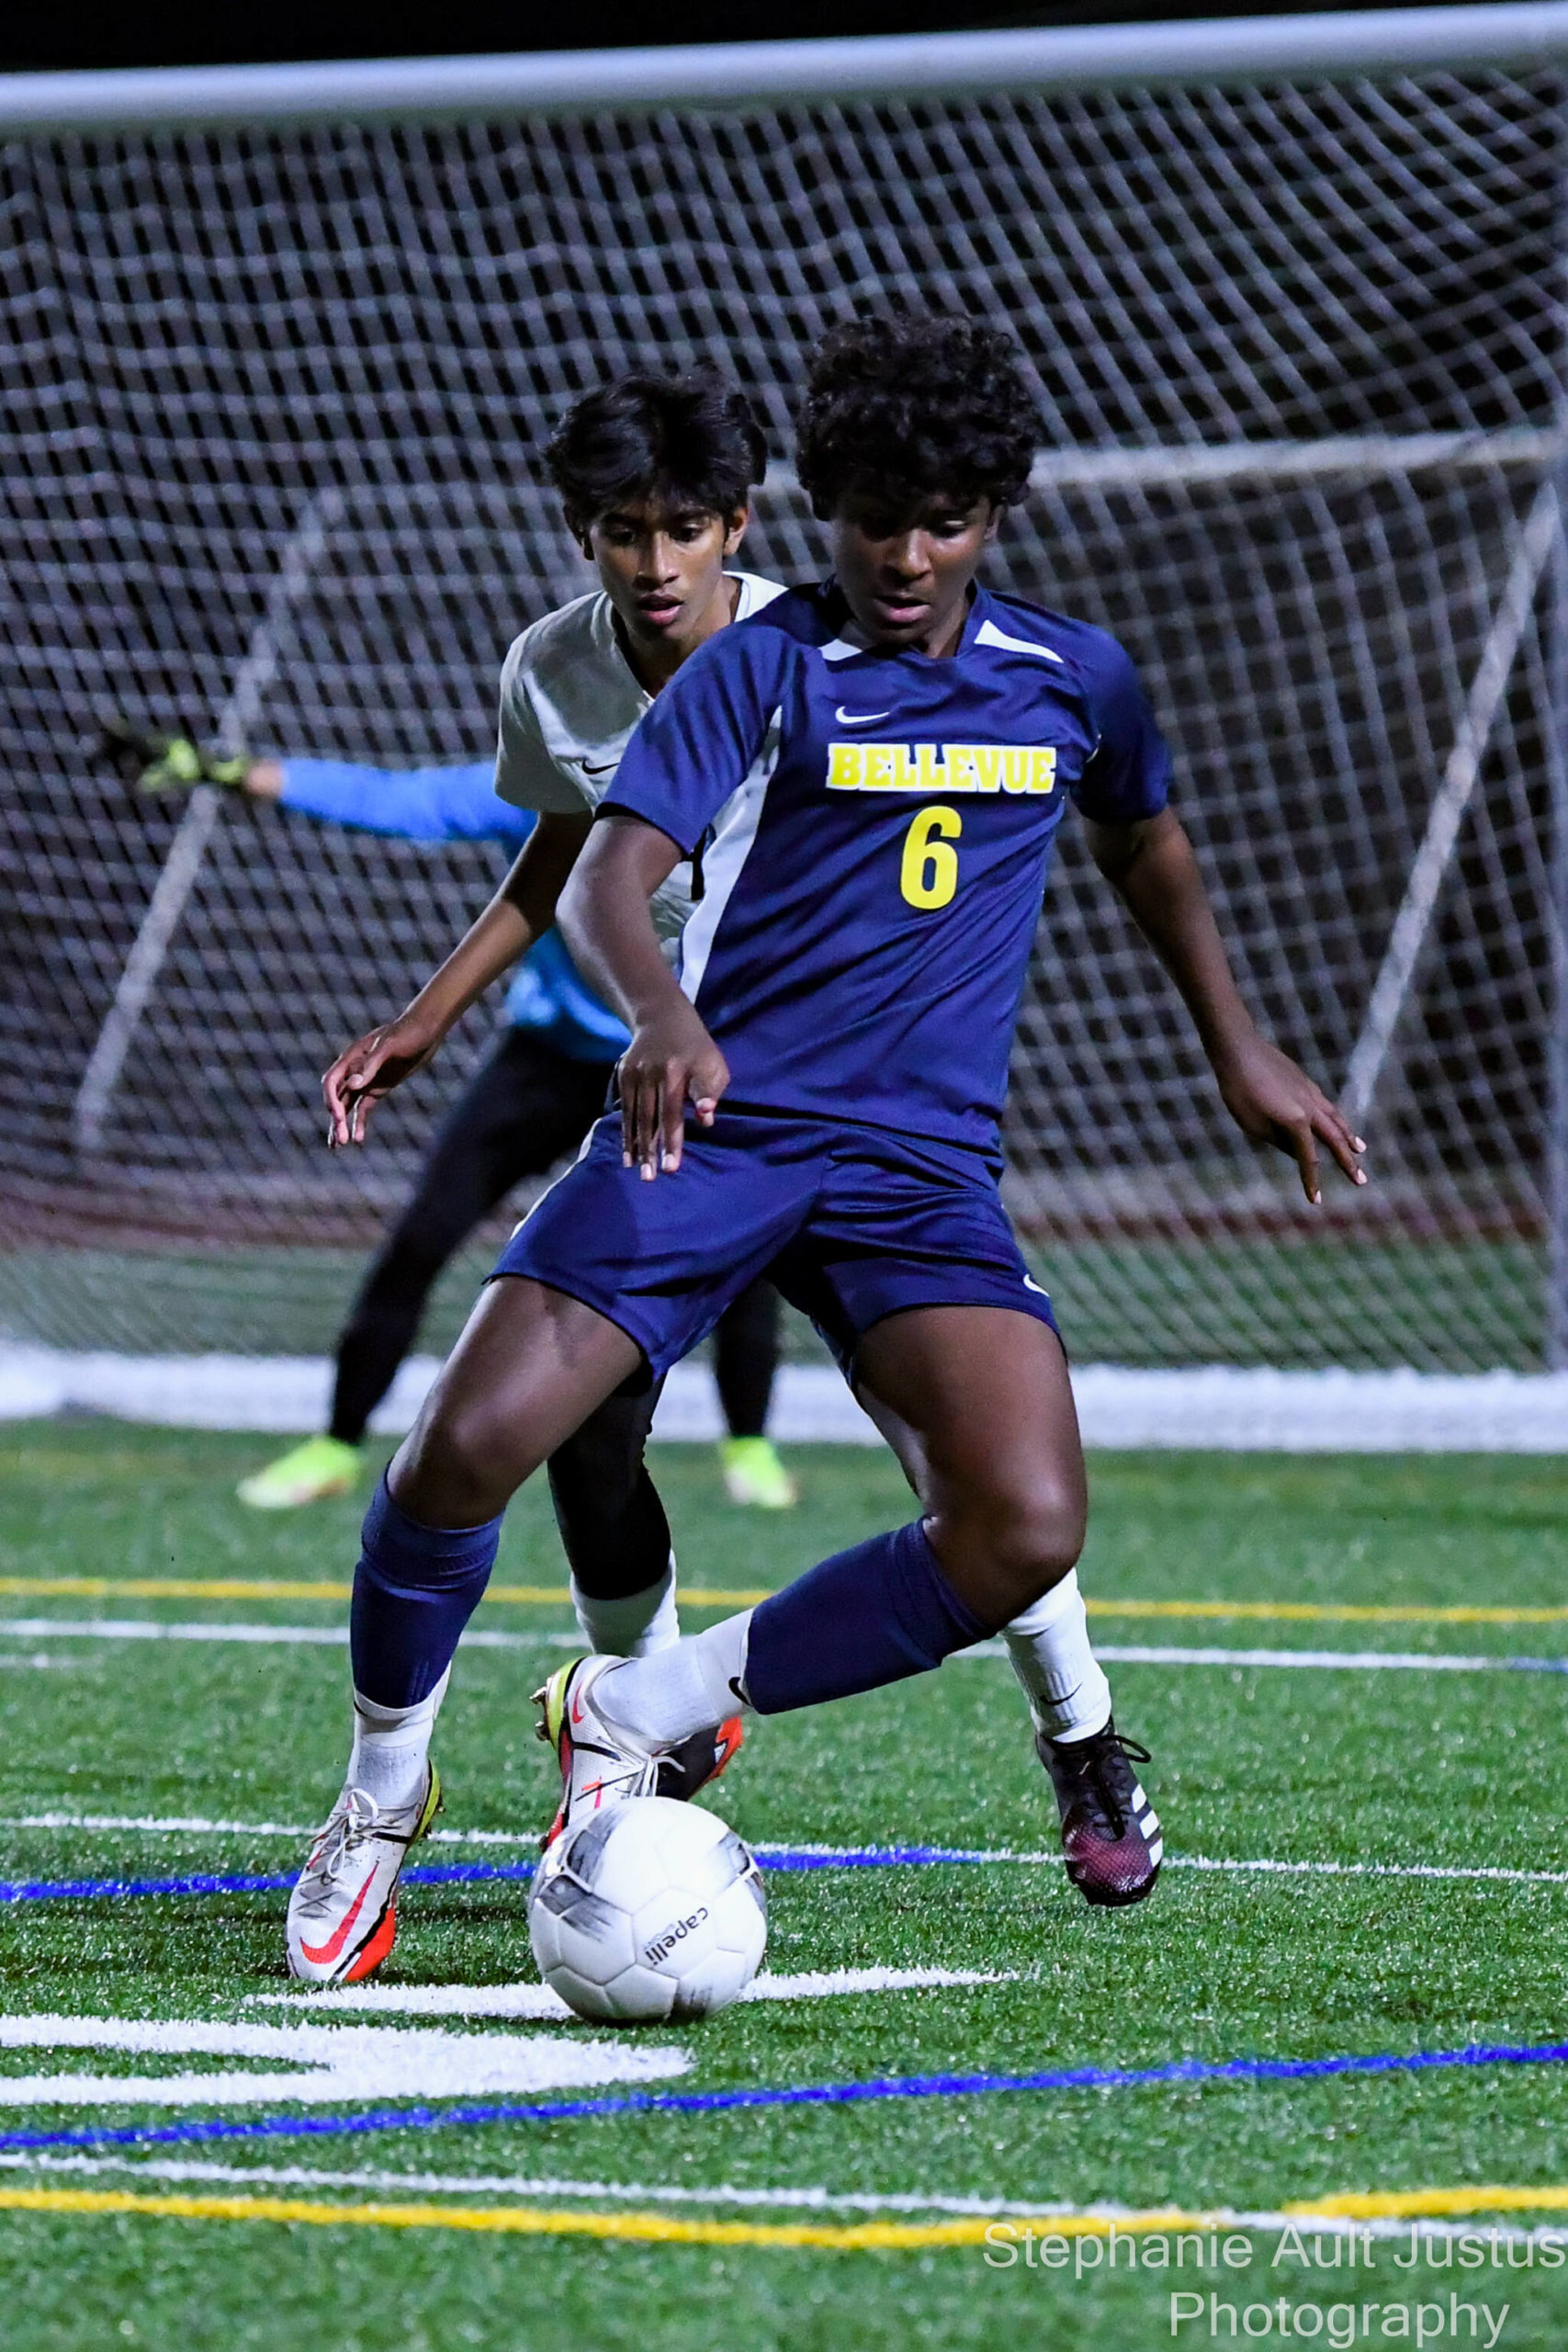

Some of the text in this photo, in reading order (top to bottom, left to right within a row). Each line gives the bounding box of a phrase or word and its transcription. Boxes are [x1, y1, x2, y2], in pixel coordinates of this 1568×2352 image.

[827, 743, 1056, 794] BELLEVUE
[900, 805, 962, 910] 6
[645, 1906, 708, 1966] capelli
